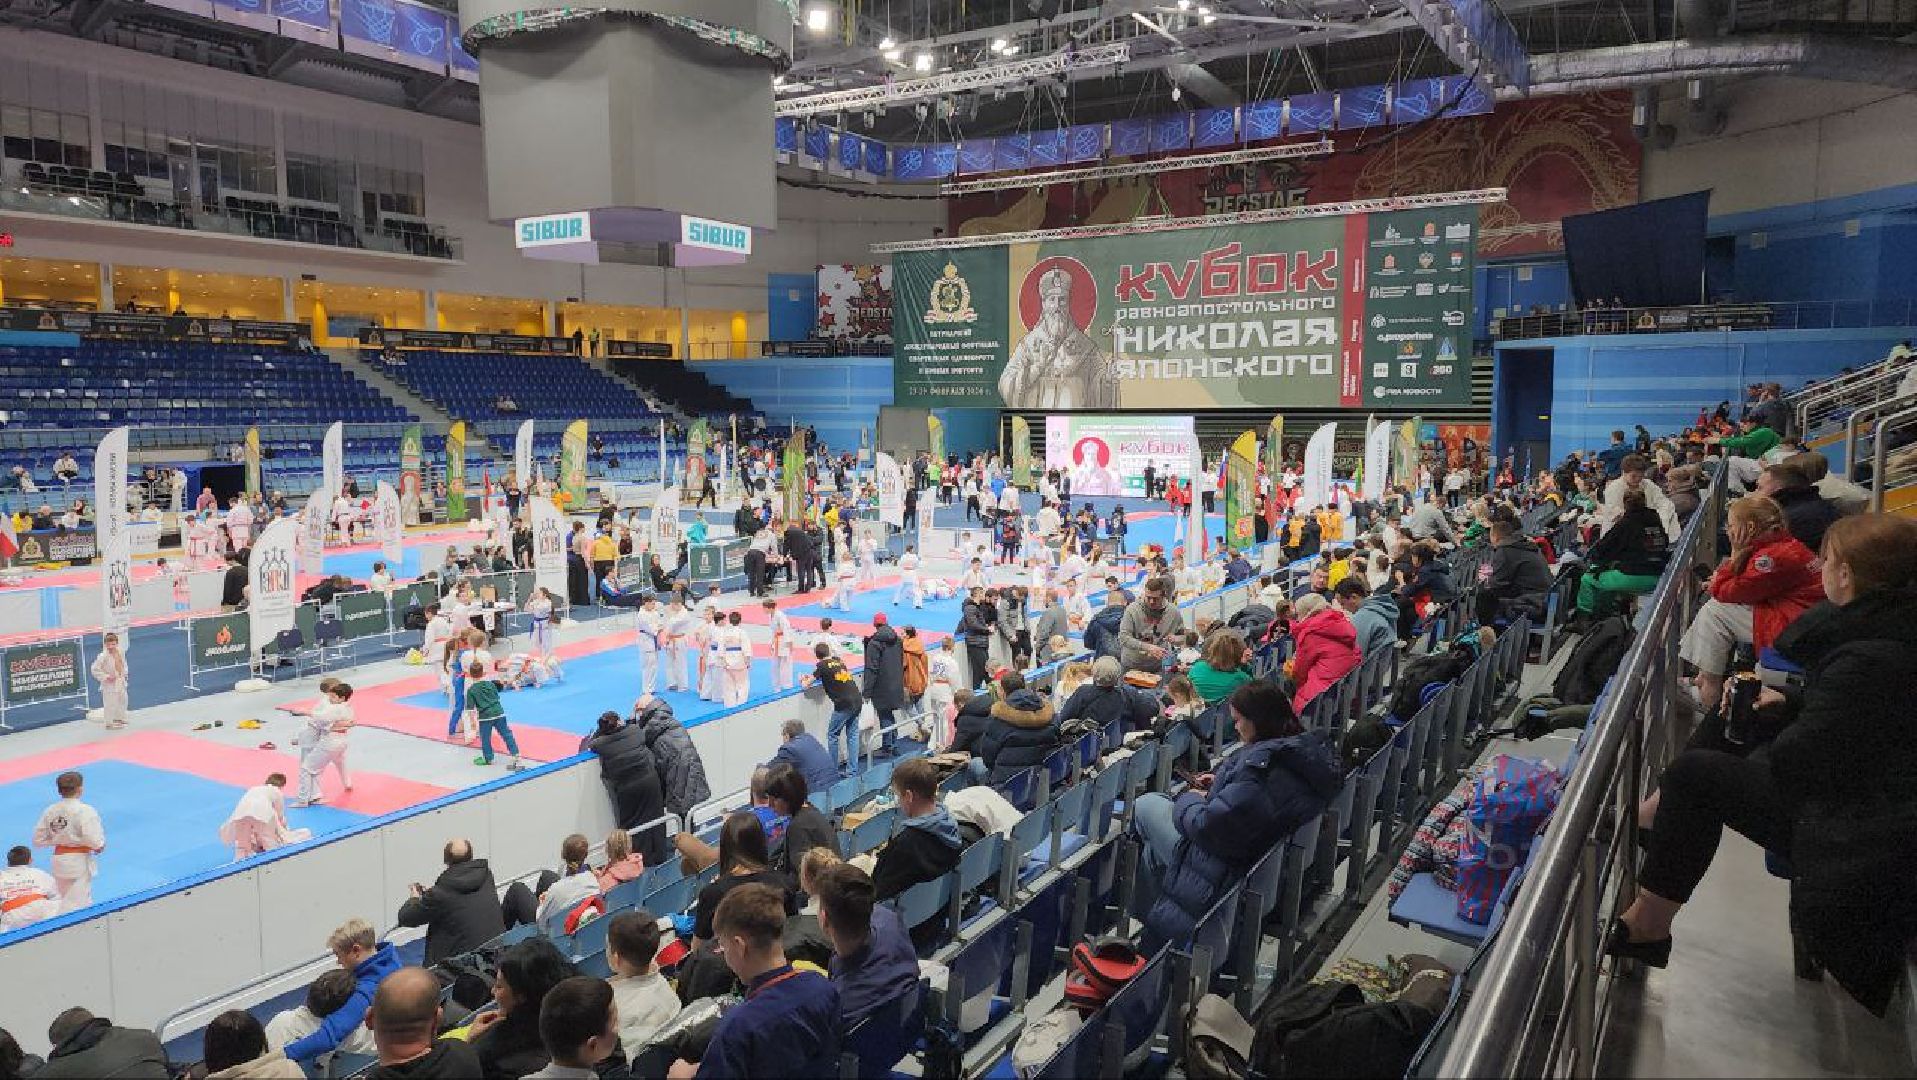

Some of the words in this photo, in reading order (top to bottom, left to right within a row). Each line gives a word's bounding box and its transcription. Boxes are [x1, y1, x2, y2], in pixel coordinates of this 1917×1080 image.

[521, 217, 583, 242] SIBUR
[689, 221, 746, 248] SIBUR
[1117, 316, 1338, 353] НИКОЛАЯ
[1116, 354, 1334, 380] ЯПОНСКОГО
